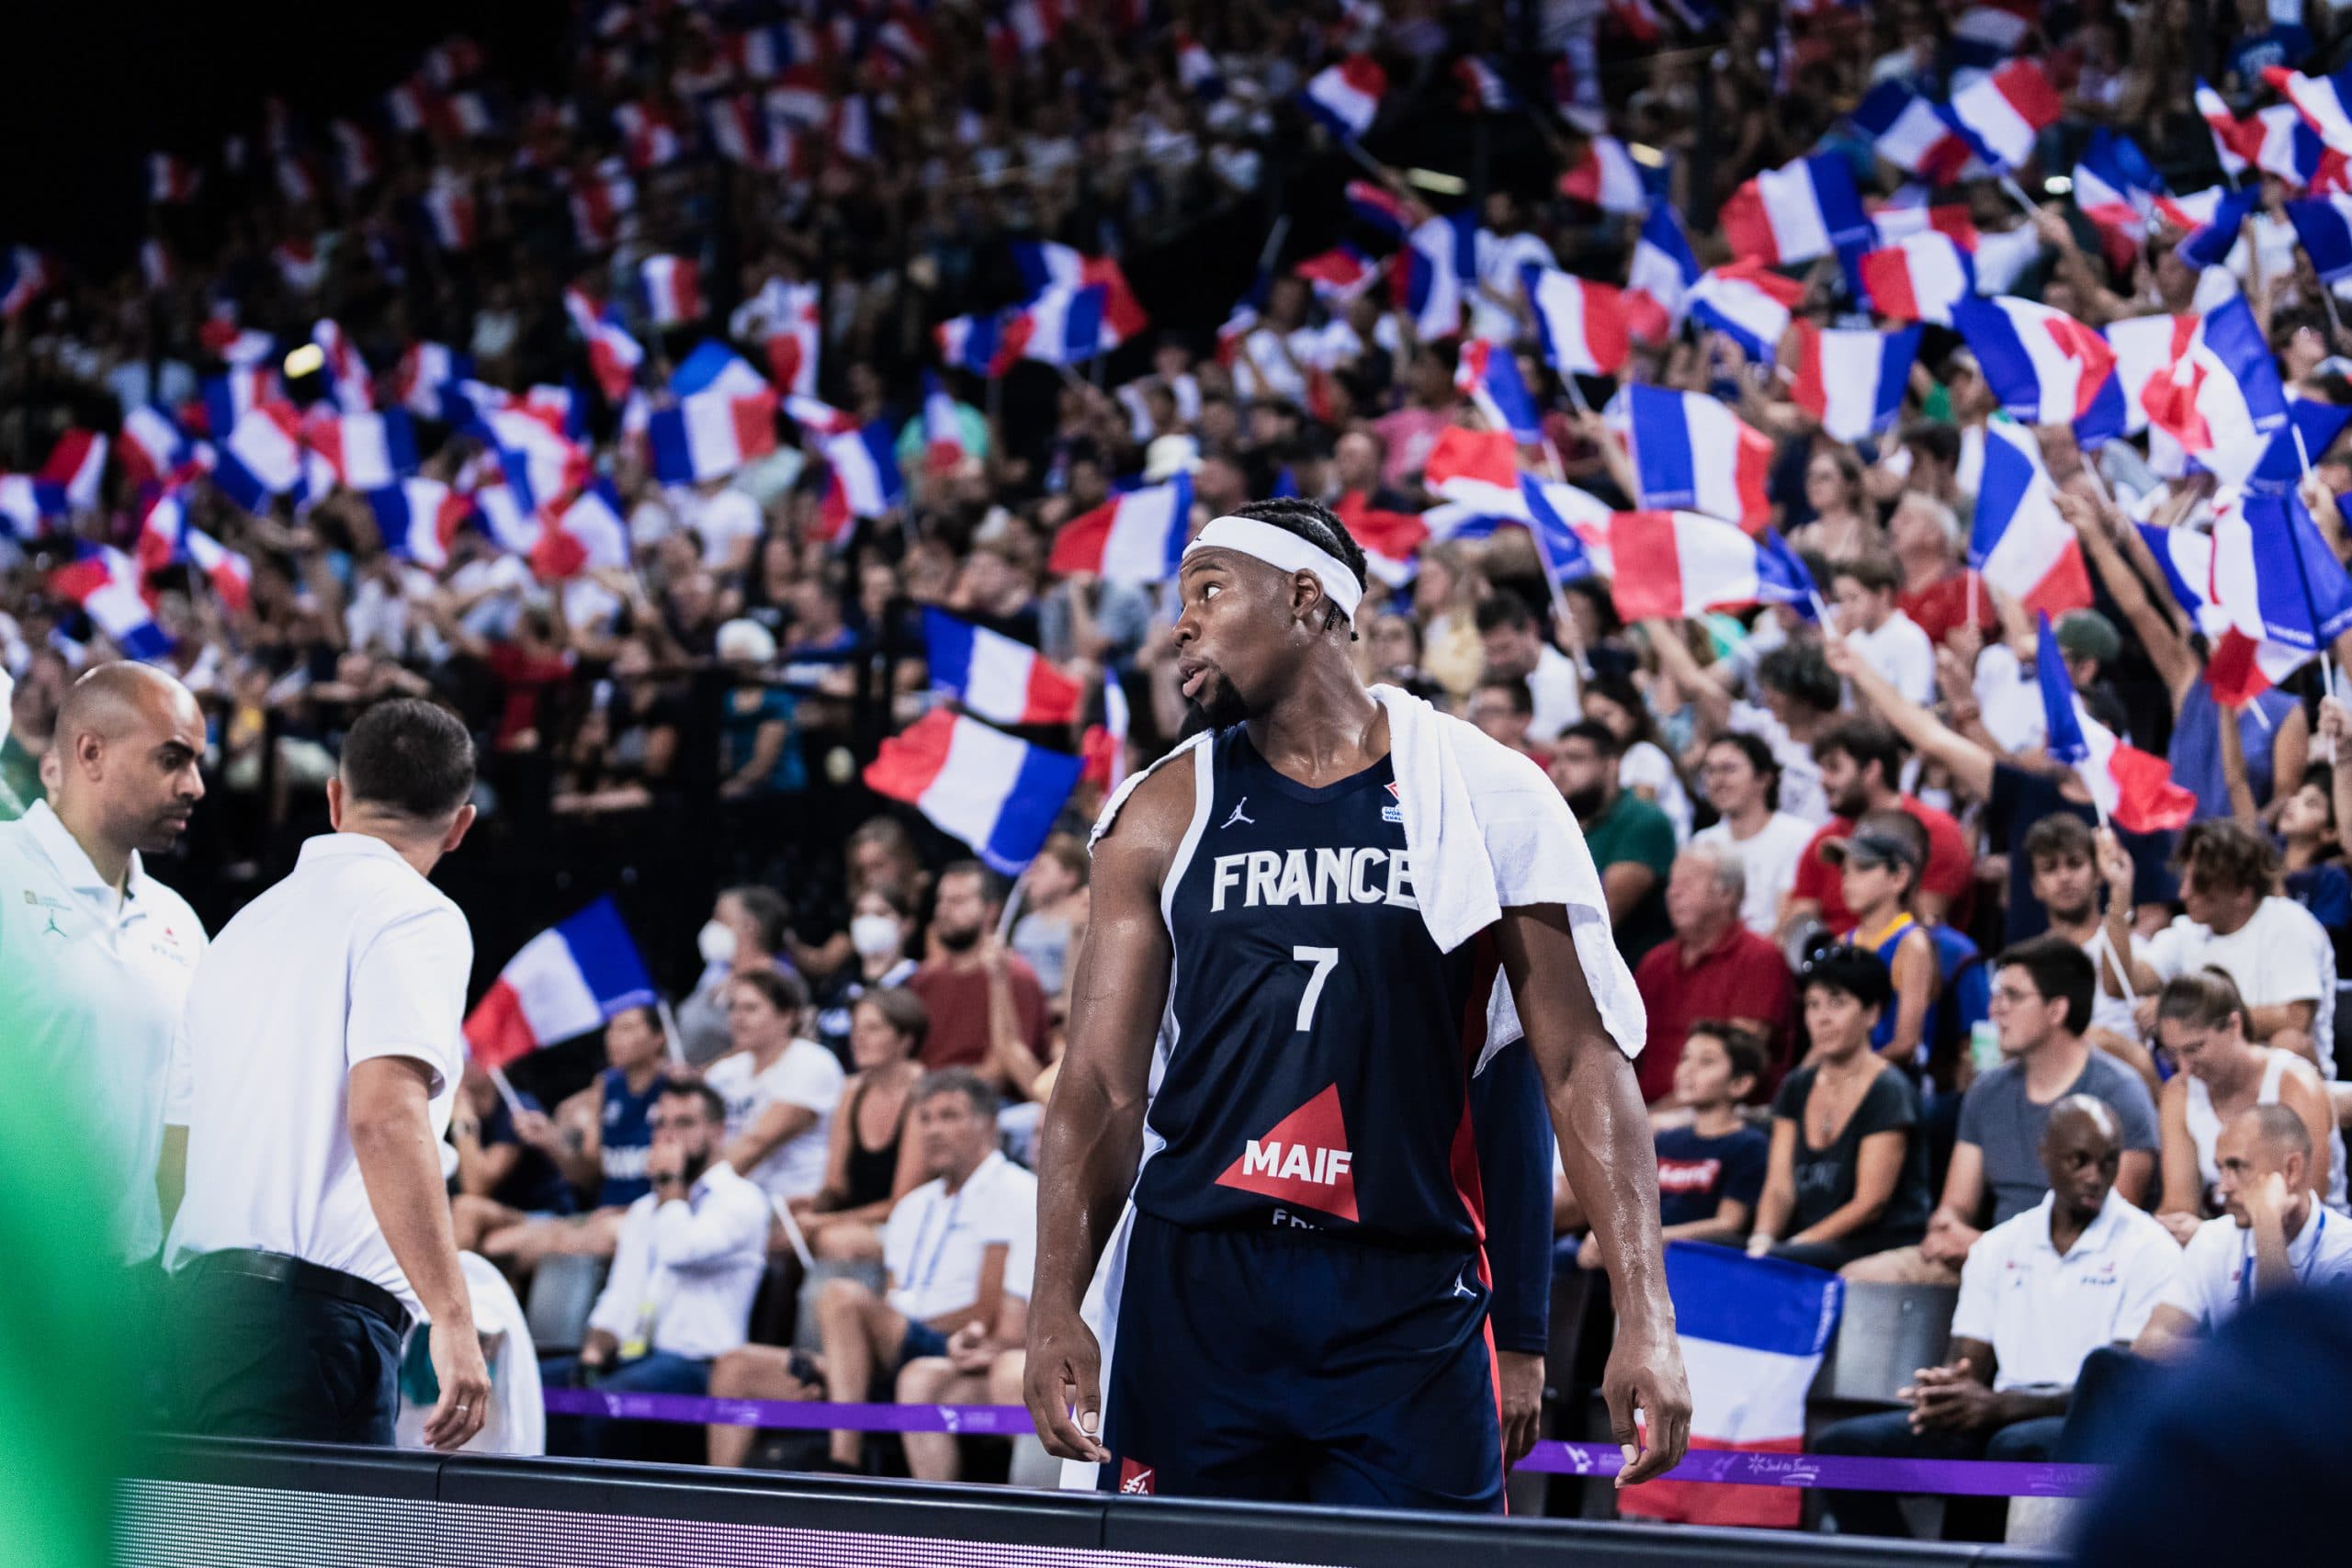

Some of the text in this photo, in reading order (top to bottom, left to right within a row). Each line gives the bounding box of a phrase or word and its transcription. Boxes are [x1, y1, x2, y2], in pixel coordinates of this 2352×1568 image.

[1210, 847, 1420, 913] FRANCE
[1293, 945, 1339, 1032] 7
[1242, 1140, 1353, 1186] MAIF
